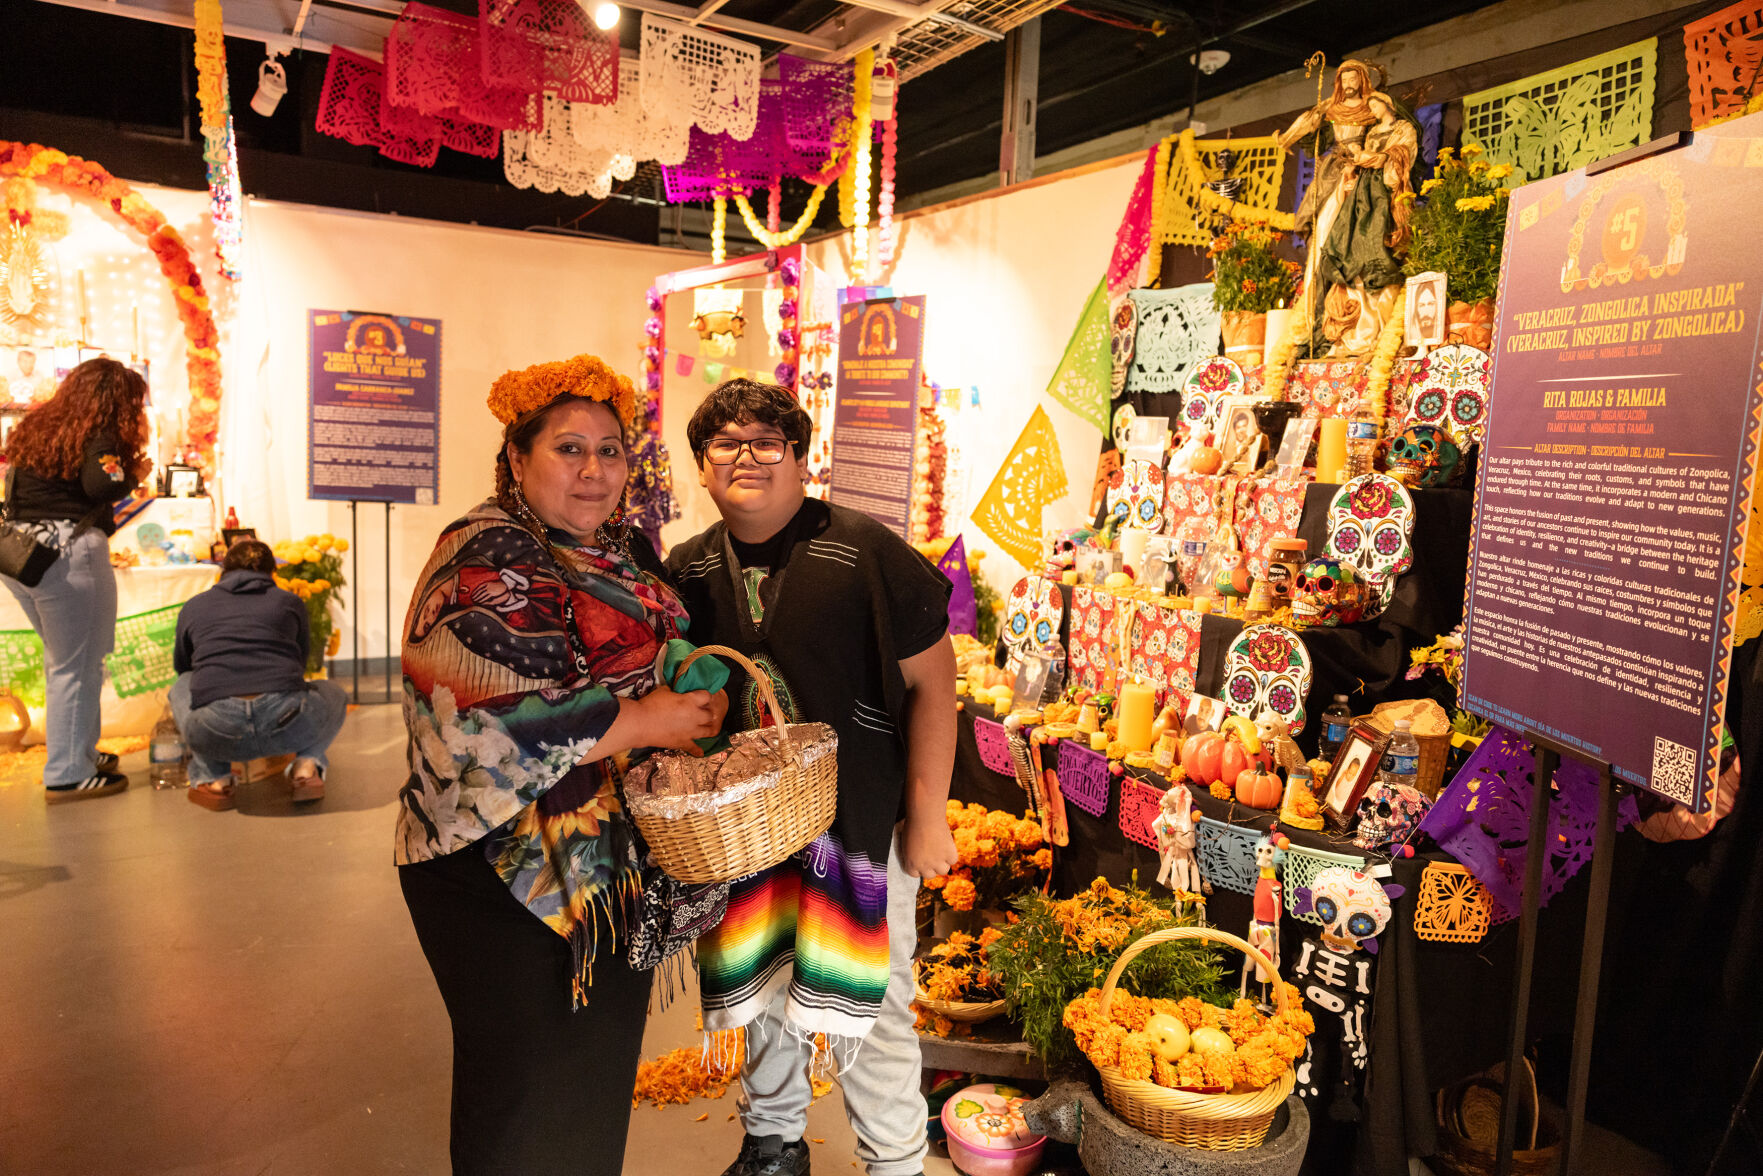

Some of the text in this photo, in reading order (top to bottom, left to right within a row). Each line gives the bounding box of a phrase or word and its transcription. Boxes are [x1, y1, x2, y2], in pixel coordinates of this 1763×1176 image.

[1609, 207, 1639, 250] #5
[1579, 295, 1648, 322] ZONGOLICA
[1506, 310, 1744, 352] (VERACRUZ, INSPIRED BY ZONGOLICA)
[1556, 343, 1662, 361] ALTAR NAME NOMBRE DEL ALTAR
[1543, 387, 1666, 407] RITA ROJAS & FAMILIA
[1546, 422, 1654, 434] FAMILY NAME NOMBRE DE FAMILIA
[1533, 443, 1665, 458] ALTAR DESCRIPTION DESCRIPCIÓN DEL ALTAR
[1585, 473, 1729, 491] roots, customs, and symbols that have
[1587, 461, 1730, 479] colorful traditional cultures of Zongolica,
[1555, 492, 1582, 501] traditions
[1584, 495, 1605, 504] evolve
[1608, 497, 1621, 505] and
[1623, 498, 1644, 509] adapt
[1647, 501, 1654, 509] to
[1677, 505, 1725, 516] generations.
[1578, 483, 1727, 504] time, incorporates modern and Chicano
[1563, 525, 1589, 535] continue
[1598, 528, 1619, 539] inspire
[1633, 535, 1672, 548] community
[1674, 540, 1696, 552] today.
[1699, 543, 1705, 552] It
[1706, 544, 1713, 553] is
[1585, 518, 1721, 543] present, showing how the values, music,
[1584, 549, 1716, 579] traditions continue to build.
[1616, 543, 1638, 555] bridge
[1640, 547, 1670, 559] between
[1672, 552, 1684, 561] the
[1686, 554, 1719, 568] heritage
[1549, 576, 1581, 588] celebrando
[1615, 590, 1654, 604] costumbres
[1697, 607, 1712, 617] que
[1571, 568, 1714, 605] ricas coloridas culturas tradicionales de
[1576, 603, 1709, 642] nuestras tradiciones evolucionan y se
[1585, 594, 1606, 605] mismo
[1609, 599, 1633, 612] tiempo,
[1637, 605, 1670, 620] incorpora
[1688, 617, 1711, 629] toque
[1549, 628, 1570, 639] pasado
[1576, 636, 1604, 650] presente,
[1605, 644, 1641, 660] mostrando
[1662, 658, 1673, 669] los
[1675, 664, 1704, 679] valores,
[1556, 641, 1581, 653] nuestros
[1582, 649, 1622, 666] antepasados
[1657, 669, 1697, 688] inspirando
[1546, 657, 1700, 715] herencia nos define las nuevas tradiciones
[1615, 668, 1648, 687] identidad,
[1654, 682, 1691, 699] resiliencia
[1696, 695, 1702, 704] y
[1063, 770, 1102, 801] MUERTOS
